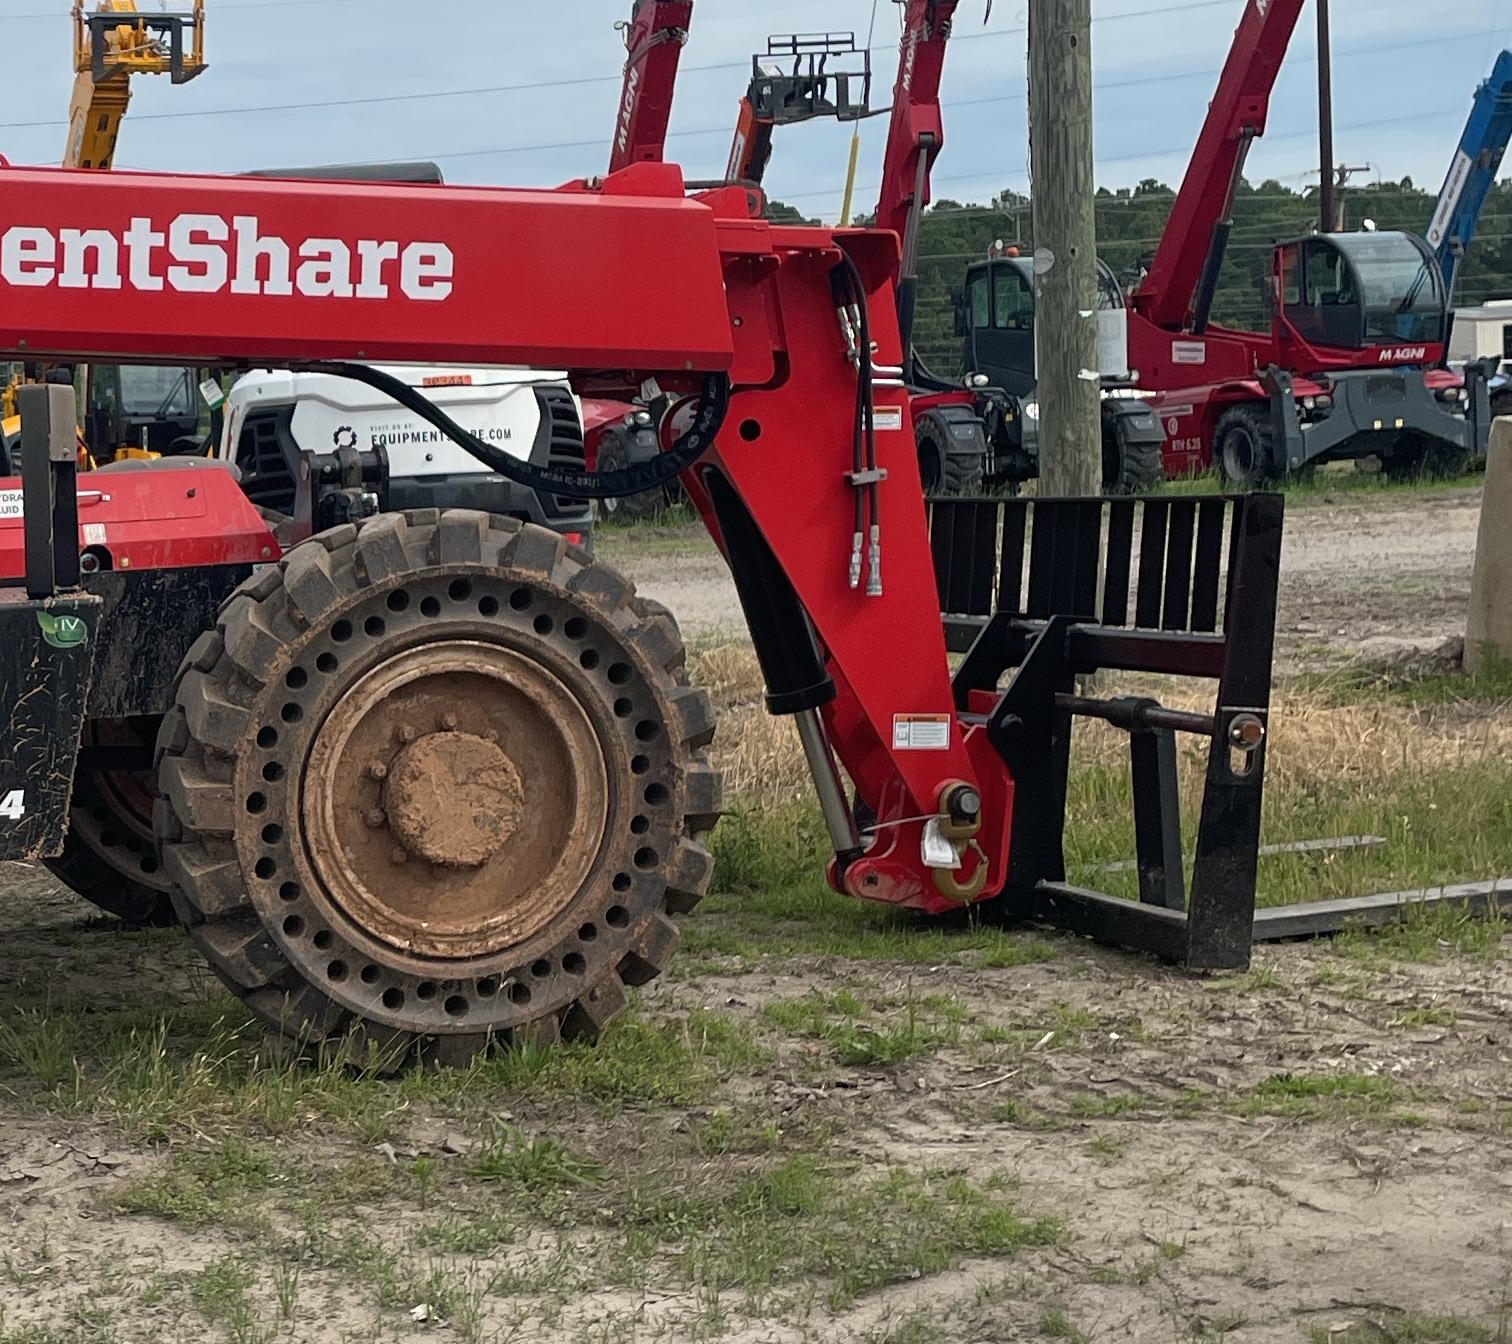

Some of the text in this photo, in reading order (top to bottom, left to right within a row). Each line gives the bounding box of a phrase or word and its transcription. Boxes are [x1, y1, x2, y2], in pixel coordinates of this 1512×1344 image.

[618, 67, 639, 153] MAGNI
[1378, 346, 1426, 362] MAGNI
[61, 618, 80, 631] IV
